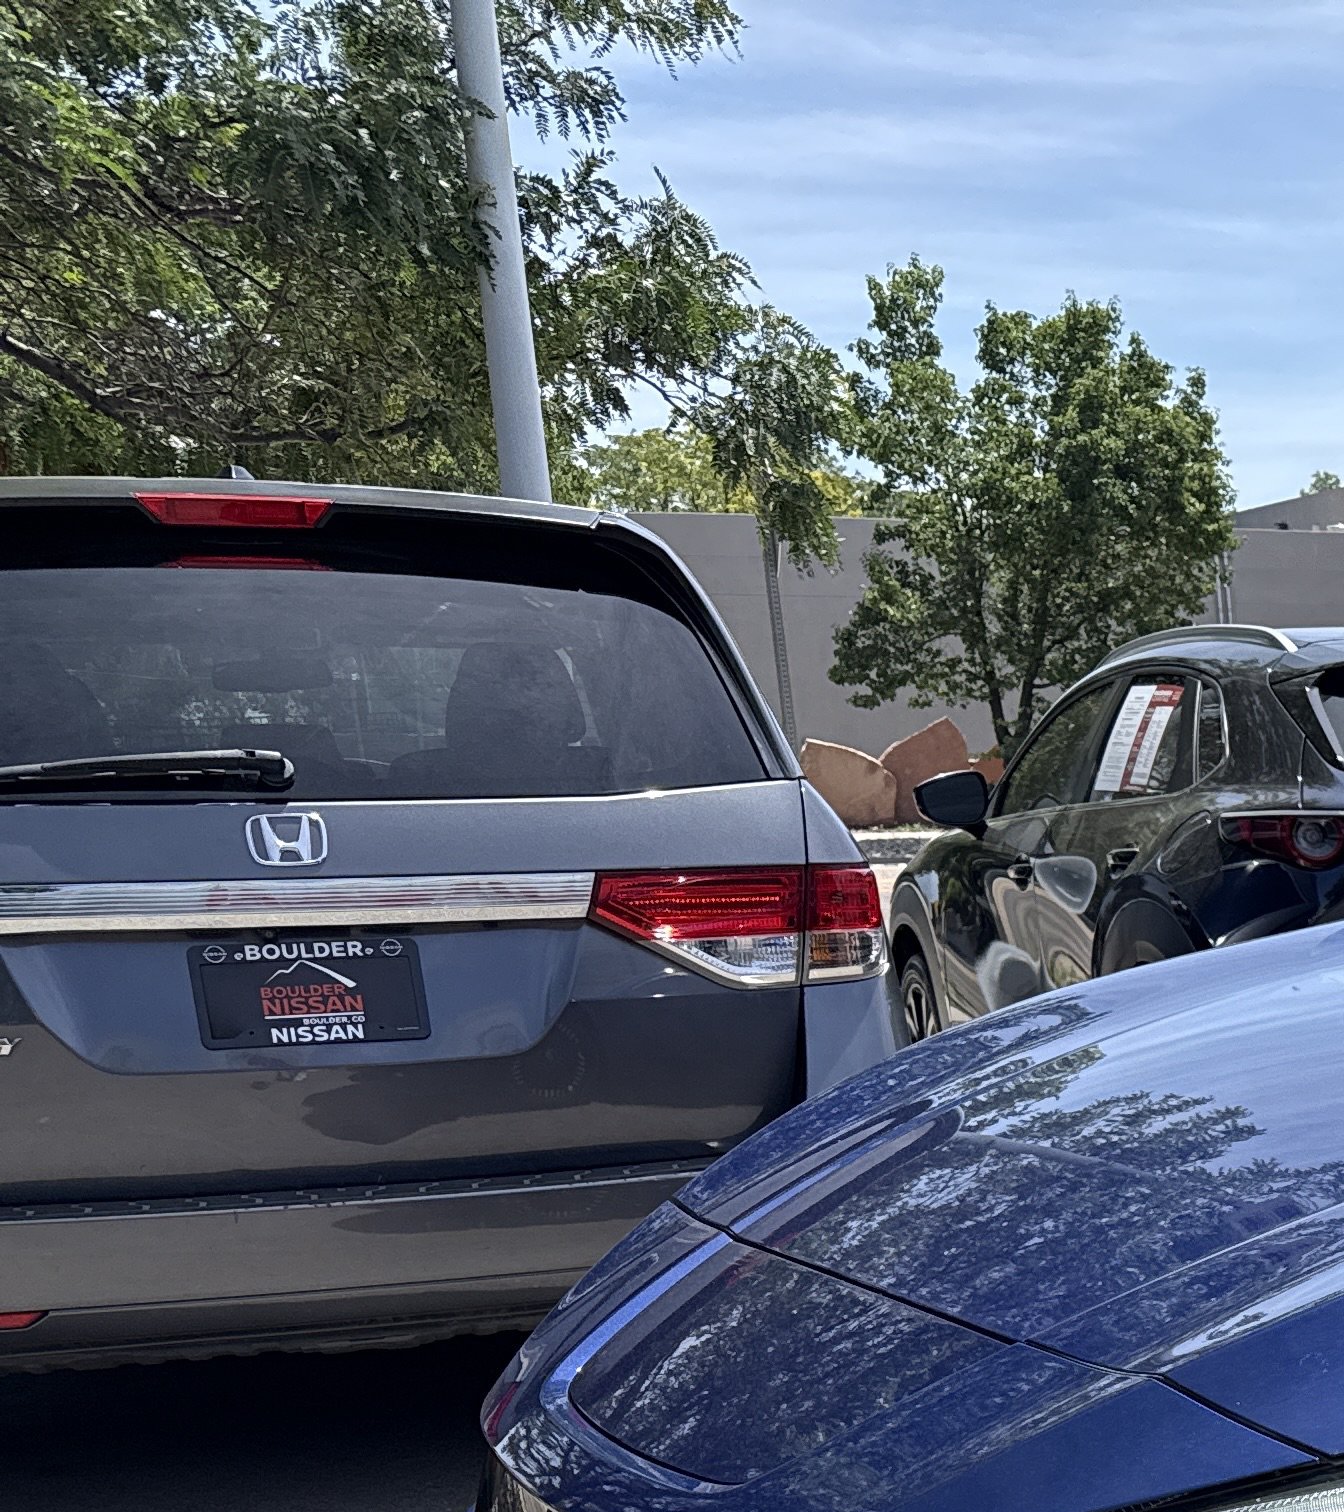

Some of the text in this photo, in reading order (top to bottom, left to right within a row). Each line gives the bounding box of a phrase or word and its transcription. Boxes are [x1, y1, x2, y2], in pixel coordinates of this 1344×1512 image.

[244, 940, 364, 961] BOULDER
[260, 983, 347, 999] BOULDER
[261, 994, 365, 1016] NISSAN
[351, 1015, 366, 1023] CO
[270, 1023, 365, 1044] NISSAN
